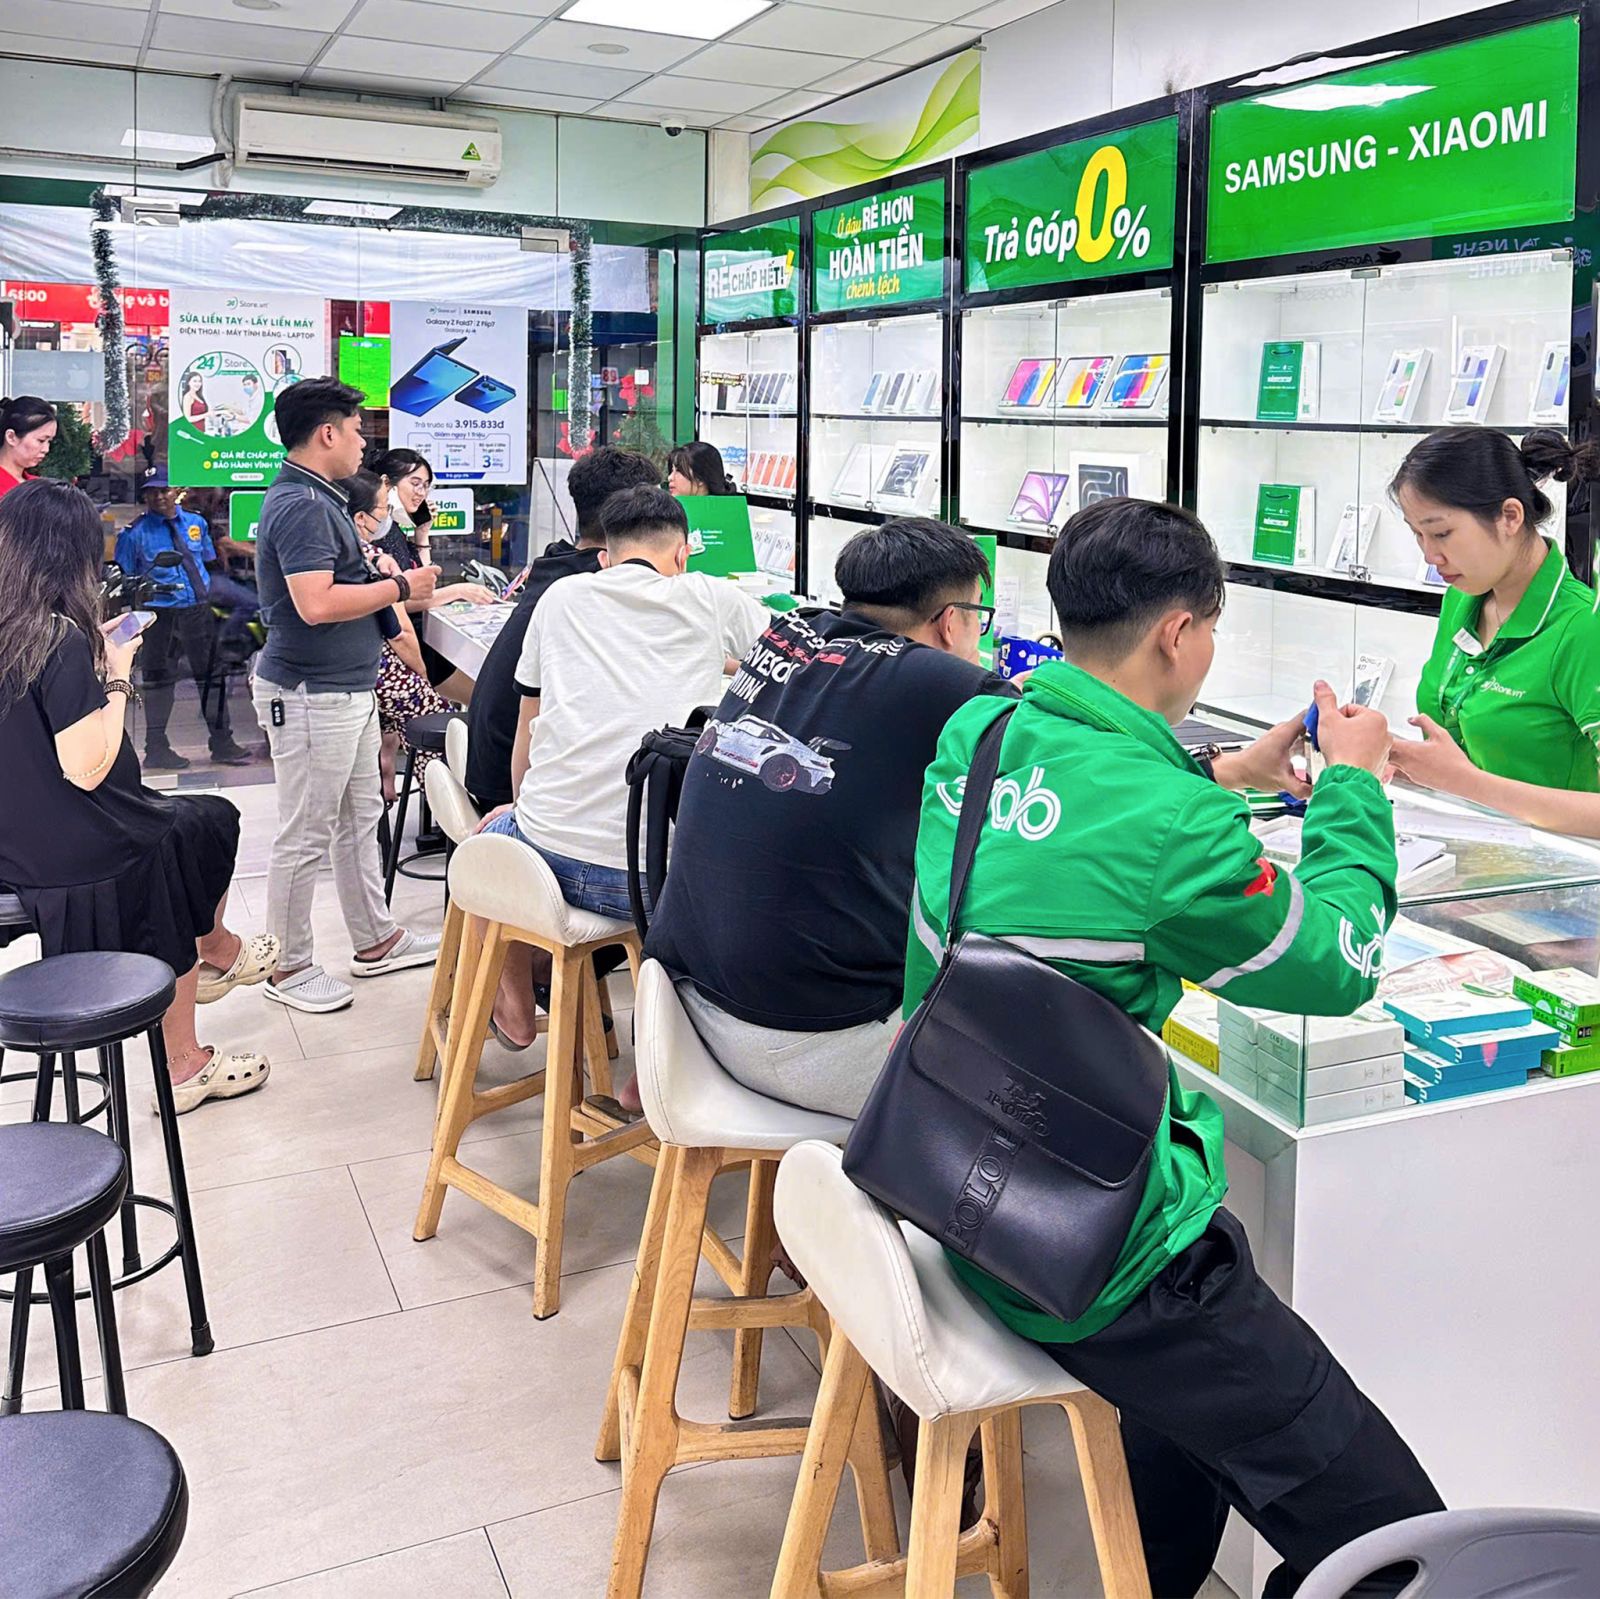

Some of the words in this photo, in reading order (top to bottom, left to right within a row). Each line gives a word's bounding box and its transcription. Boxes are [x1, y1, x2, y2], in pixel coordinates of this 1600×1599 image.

[1224, 134, 1378, 195] SAMSUNG
[1387, 146, 1399, 155] -
[1407, 99, 1548, 161] XIAOMI
[861, 196, 879, 231] RẺ
[881, 194, 914, 228] HƠN
[984, 216, 1020, 264] Trả
[1025, 209, 1078, 263] Góp
[828, 237, 876, 281] HOÀN
[878, 223, 924, 273] TIỀN
[707, 256, 731, 299] RẺ
[731, 265, 758, 293] CHẤP
[759, 260, 785, 289] HẾT!
[845, 277, 875, 300] chênh
[876, 272, 901, 300] lệch
[137, 293, 156, 308] và
[179, 312, 199, 324] SỬA
[226, 315, 243, 325] TAY
[251, 315, 269, 326] LẤY
[293, 316, 314, 328] MÁY
[425, 318, 450, 326] Galaxy
[179, 327, 197, 336] ĐIỆN
[226, 327, 242, 337] MÁY
[244, 328, 261, 337] TÍNH
[262, 329, 282, 338] BẢNG
[287, 332, 315, 340] LAPTOP
[196, 355, 216, 370] 24
[415, 421, 426, 429] Trả
[455, 419, 505, 430] 3.915.833đ
[451, 432, 467, 440] ngay
[220, 450, 235, 459] GIÁ
[236, 450, 245, 459] RẺ
[247, 450, 268, 459] CHẤP
[269, 450, 284, 459] HẾT
[482, 454, 491, 468] 3
[213, 460, 229, 469] BẢO
[230, 460, 252, 469] HÀNH
[254, 460, 273, 469] VĨNH
[936, 765, 1062, 842] Gab
